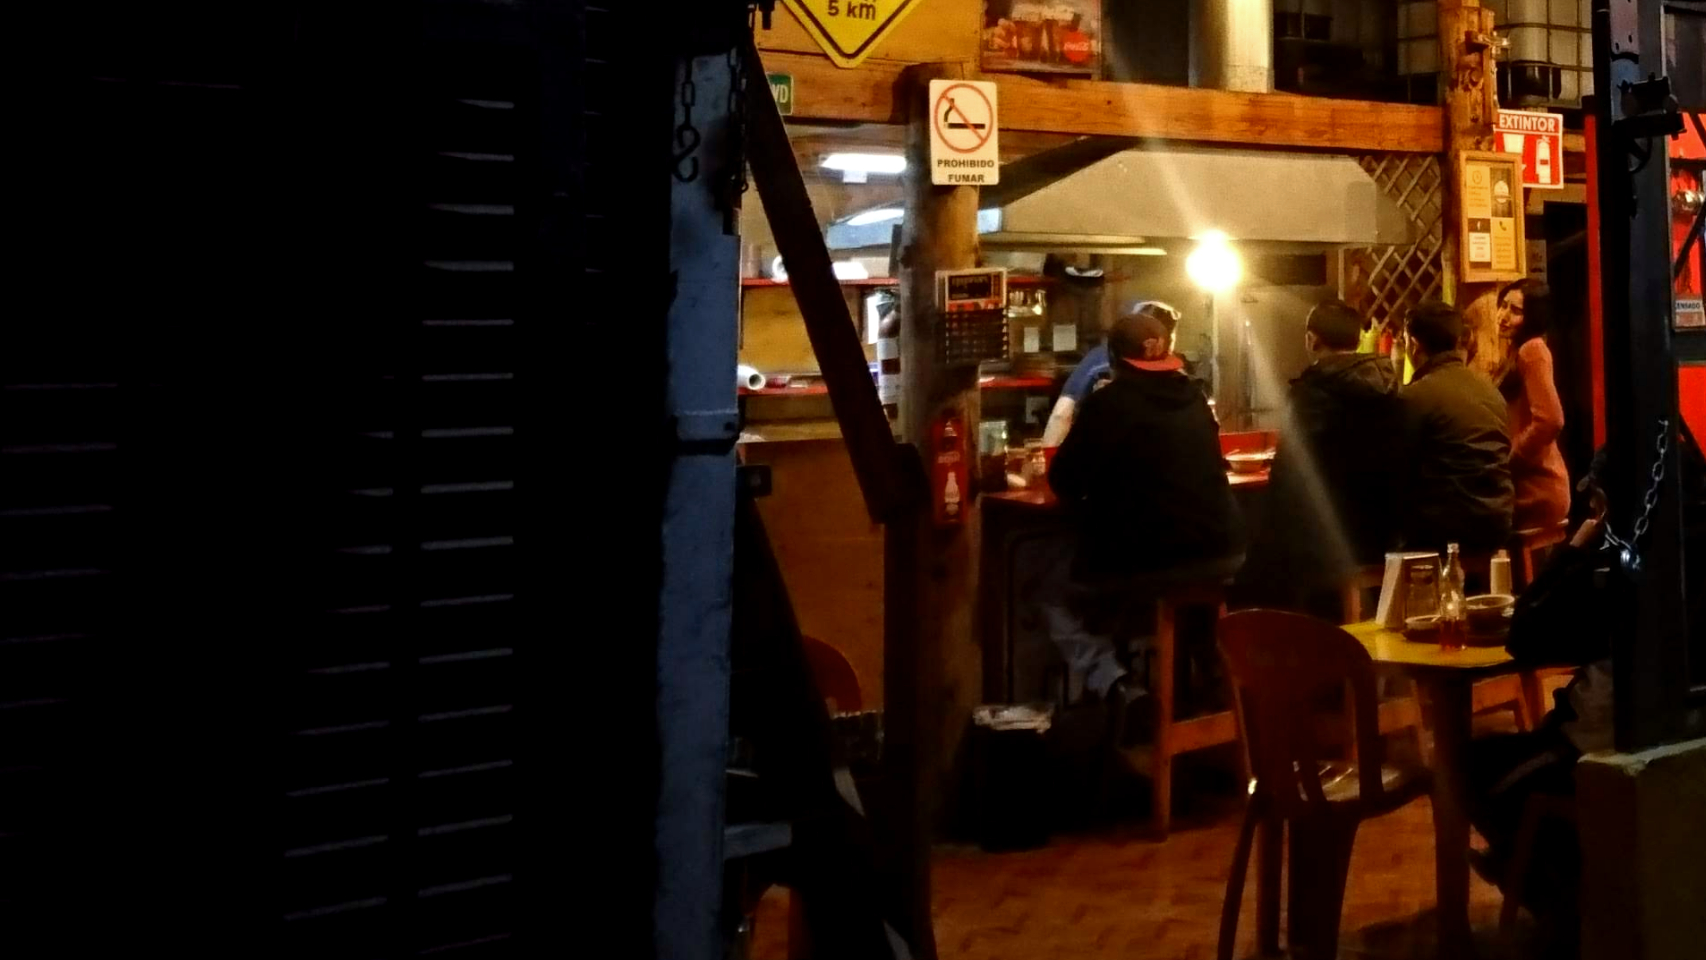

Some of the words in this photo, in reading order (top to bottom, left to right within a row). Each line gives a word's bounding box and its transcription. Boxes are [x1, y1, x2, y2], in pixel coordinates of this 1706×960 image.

[827, 0, 840, 16] 5
[846, 1, 876, 21] km
[1499, 113, 1556, 132] EXTINTOR
[937, 158, 995, 169] PROHIBIDO
[947, 173, 985, 183] FUMAR
